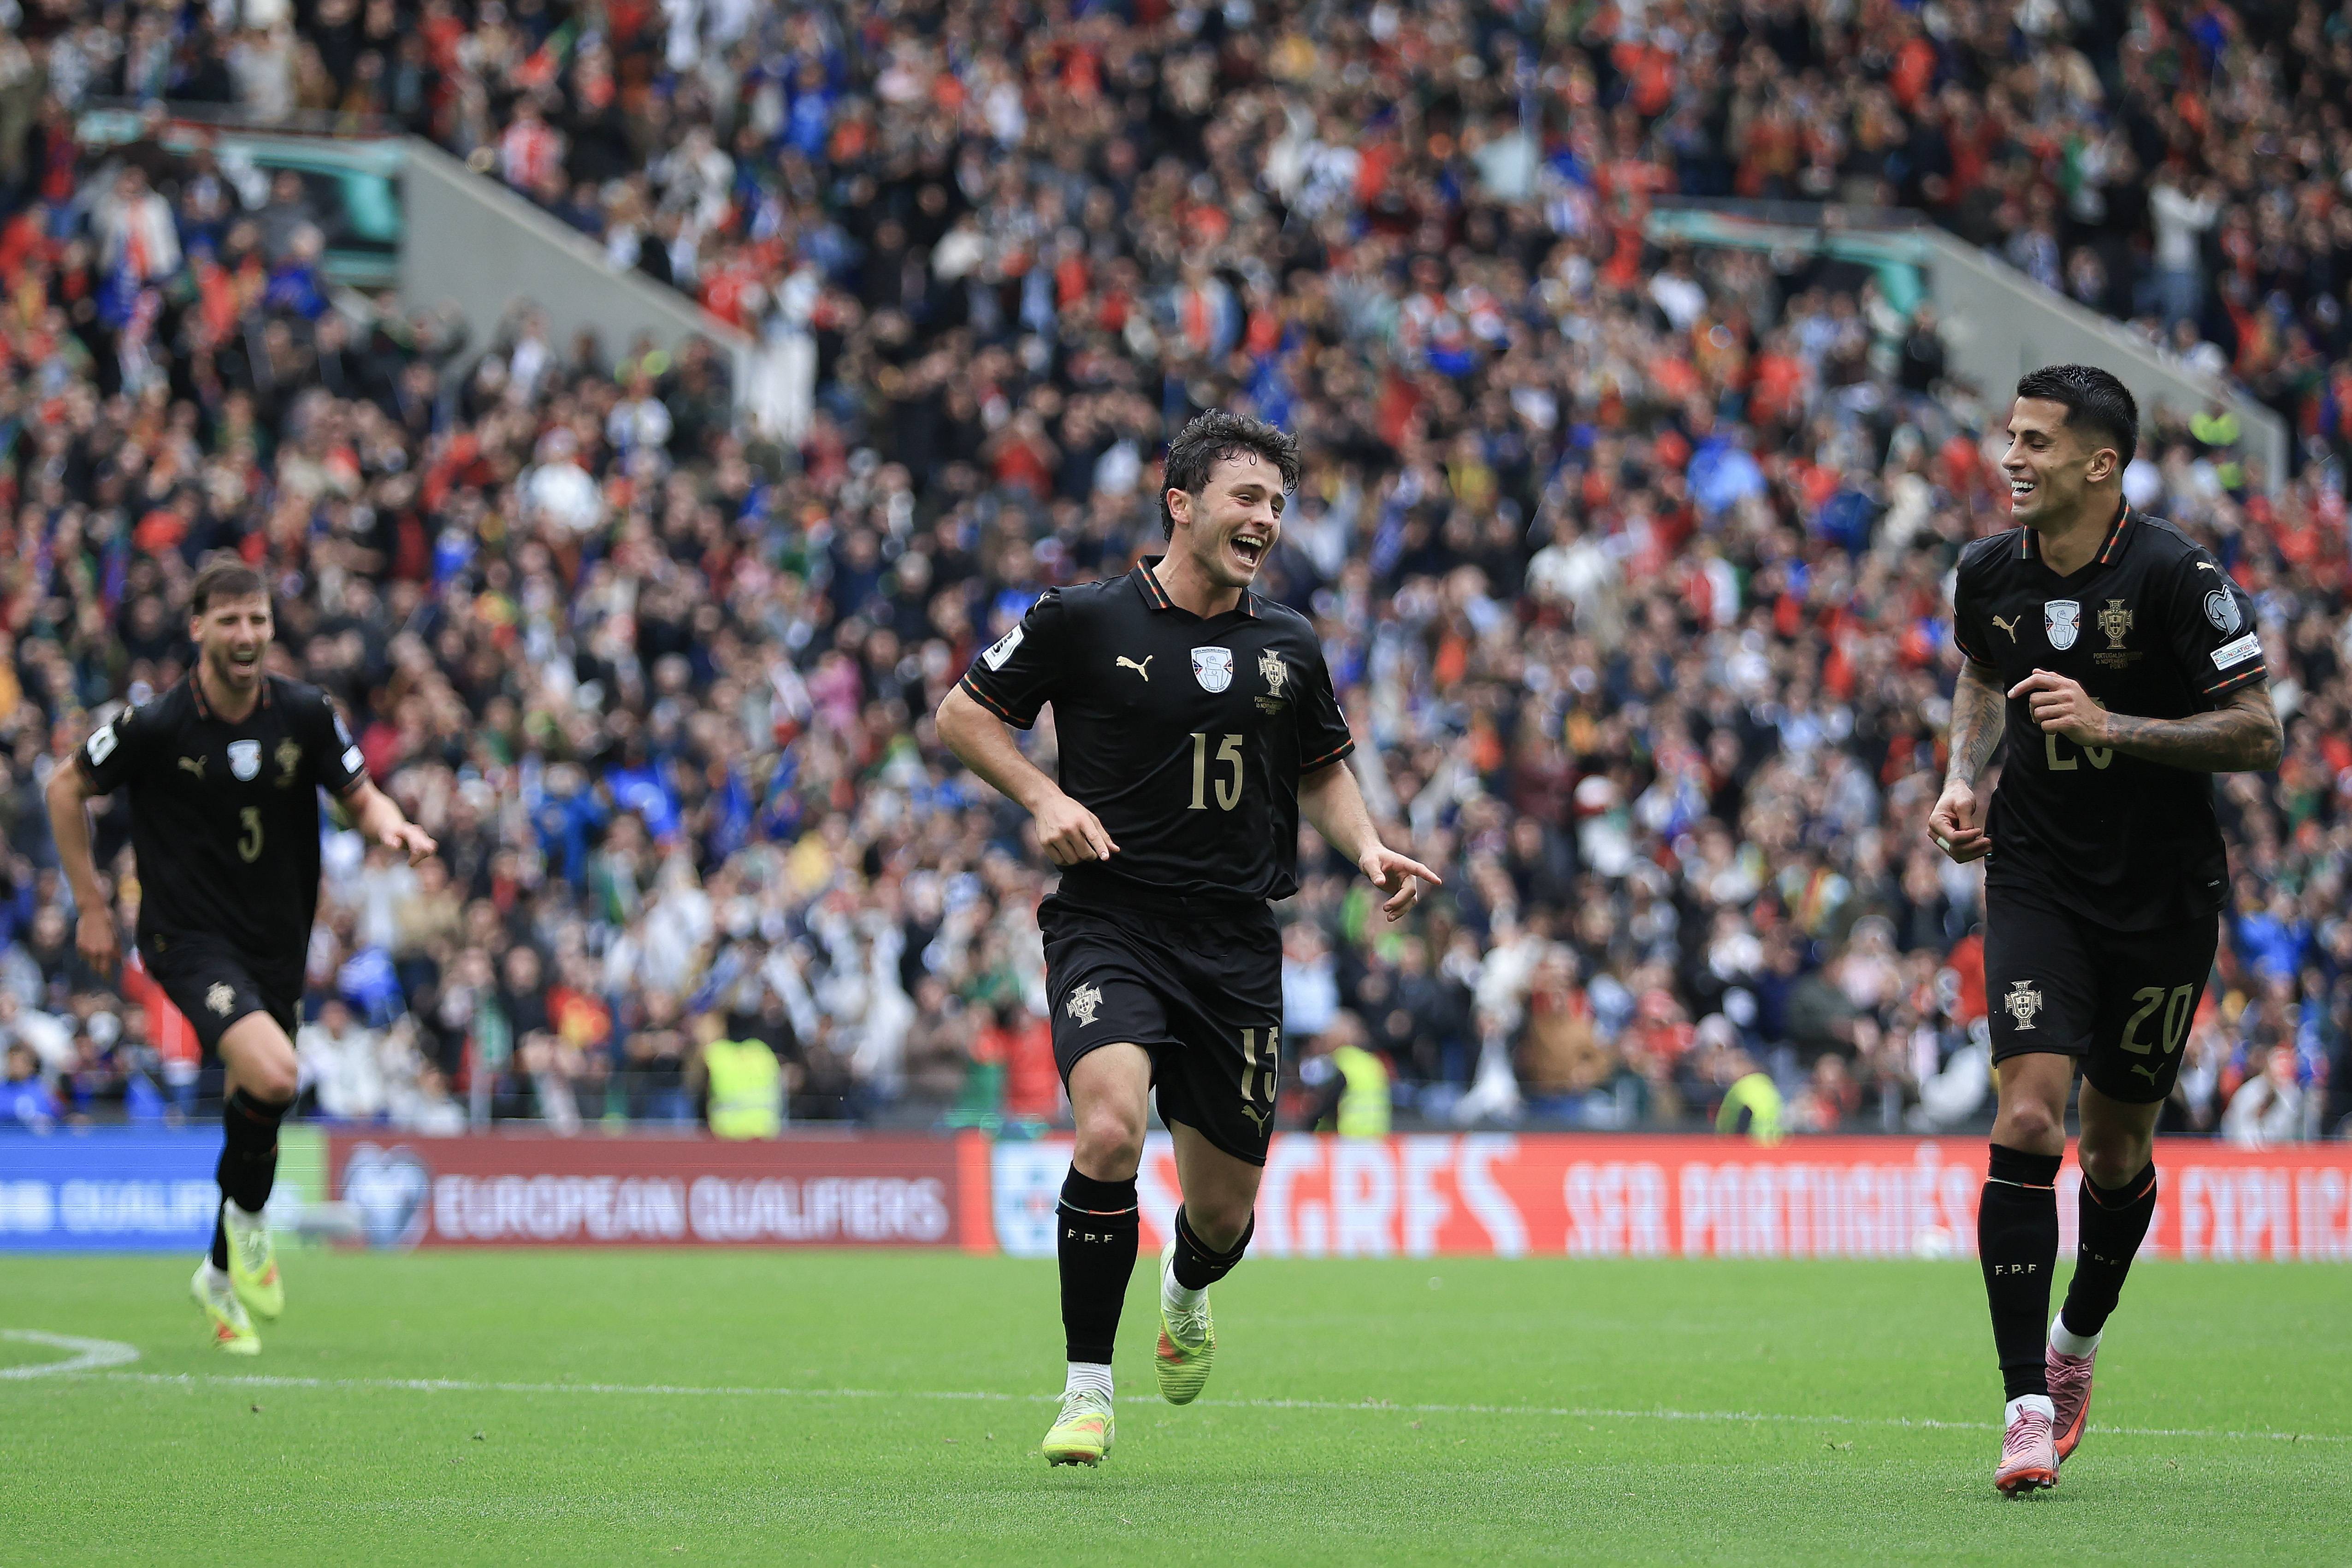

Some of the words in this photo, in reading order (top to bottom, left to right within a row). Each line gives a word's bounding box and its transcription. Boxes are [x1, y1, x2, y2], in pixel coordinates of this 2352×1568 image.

[2215, 644, 2253, 663] FOUNDATION
[1187, 733, 1243, 811] 15
[237, 806, 264, 864] 3
[2120, 982, 2193, 1055] 20
[1239, 1026, 1279, 1103] 15
[432, 1174, 686, 1241] EUROPEAN
[688, 1175, 950, 1242] QUALIFIERS
[1563, 1160, 1668, 1260] SER
